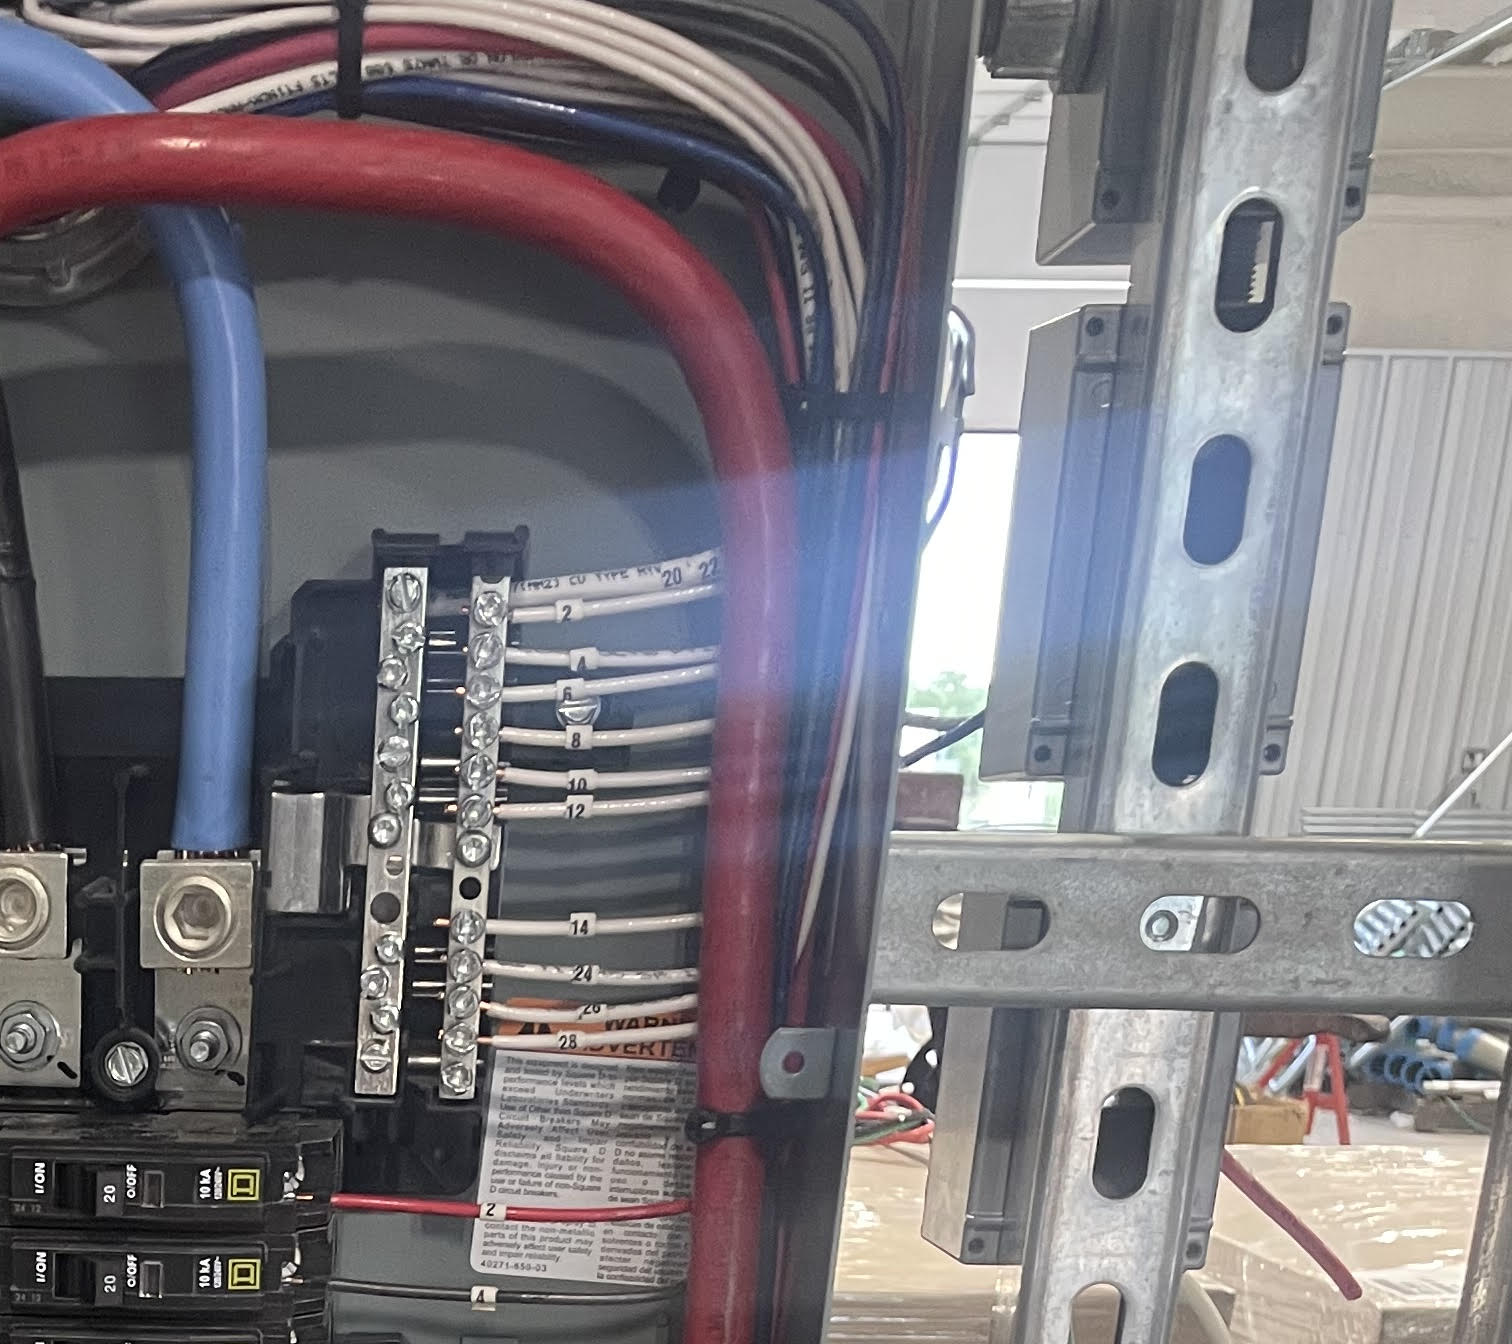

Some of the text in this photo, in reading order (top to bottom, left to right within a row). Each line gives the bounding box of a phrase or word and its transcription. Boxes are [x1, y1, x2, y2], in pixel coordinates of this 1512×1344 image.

[662, 566, 682, 587] 20
[561, 605, 572, 622] 2
[571, 733, 581, 748] 8
[568, 777, 587, 791] 10
[567, 804, 585, 819] 12
[573, 919, 589, 935] 14
[575, 966, 592, 982] 24
[559, 1034, 577, 1049] 28
[104, 1186, 115, 1202] 20
[486, 1203, 495, 1216] 2
[104, 1276, 116, 1292] 20
[475, 1290, 485, 1303] 4
